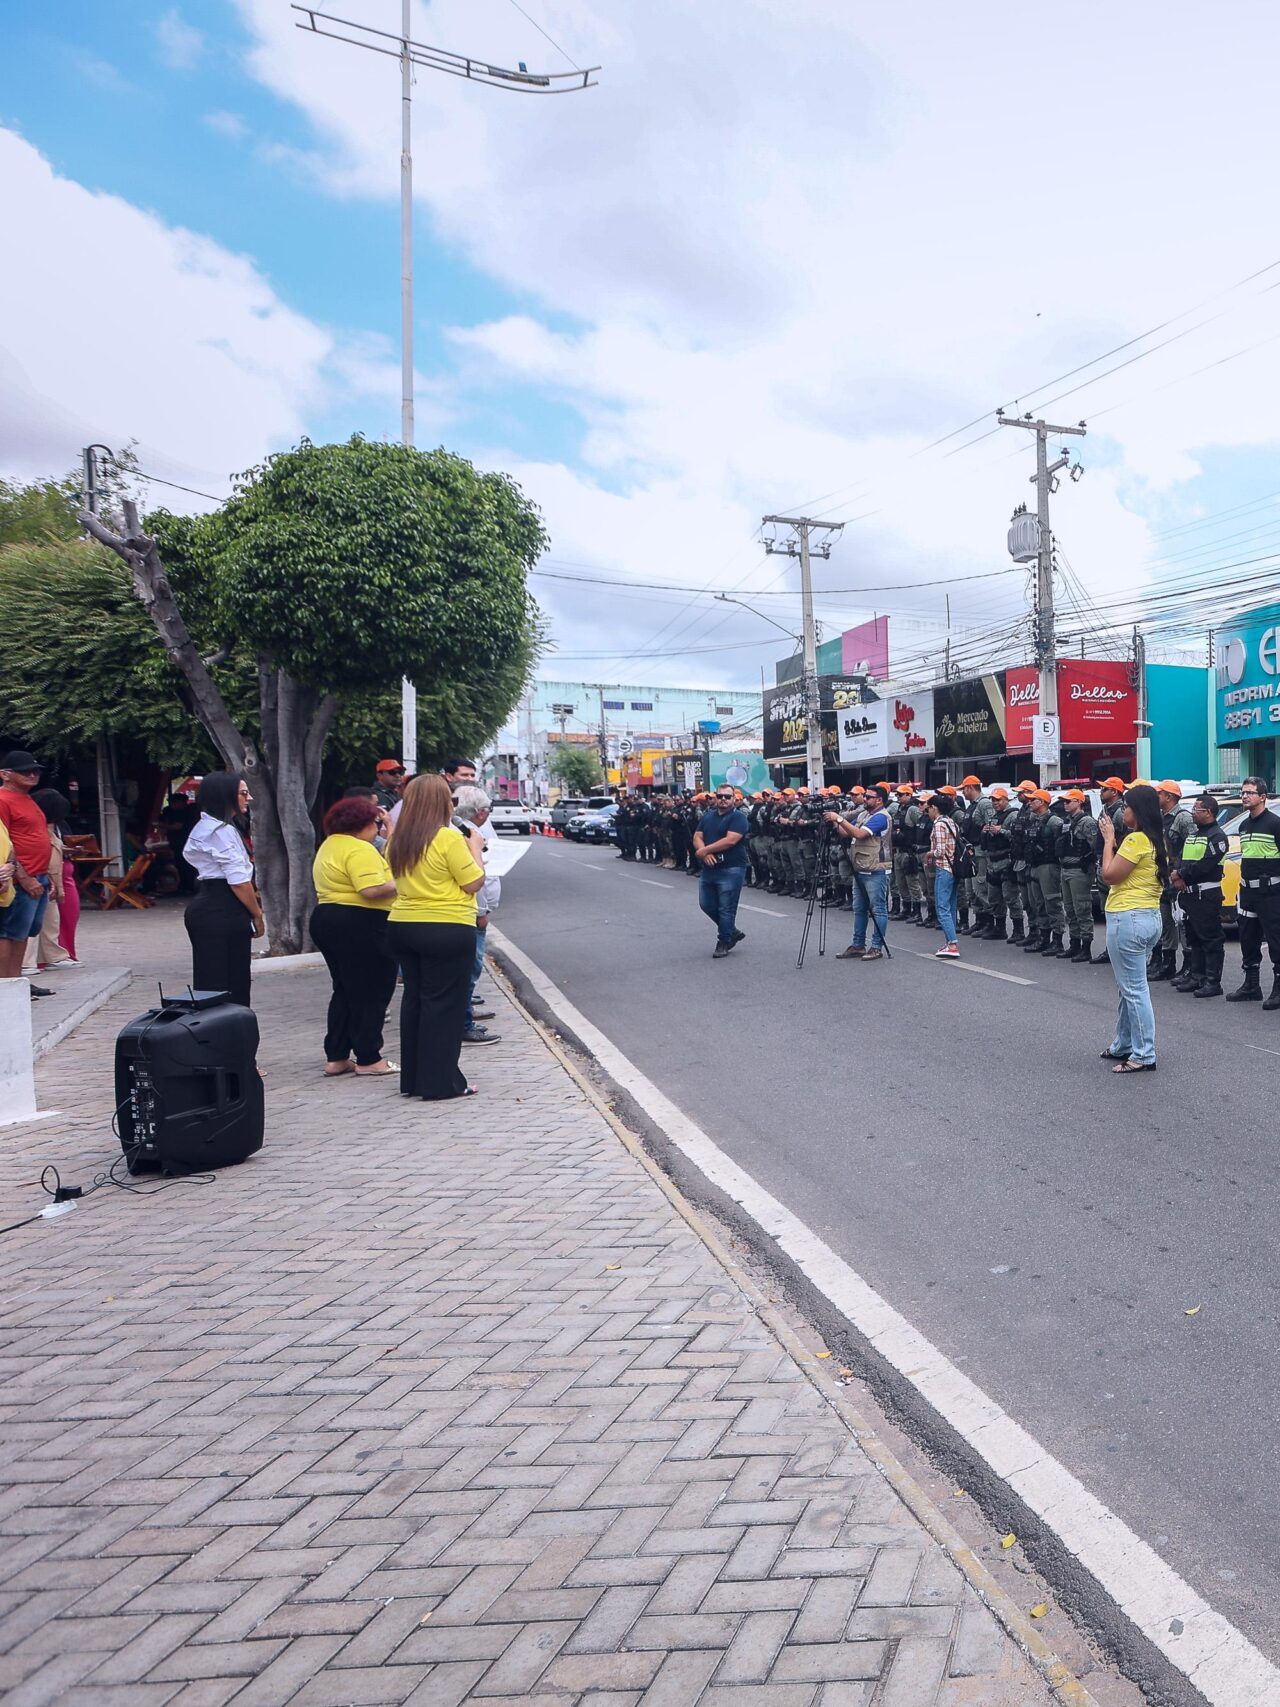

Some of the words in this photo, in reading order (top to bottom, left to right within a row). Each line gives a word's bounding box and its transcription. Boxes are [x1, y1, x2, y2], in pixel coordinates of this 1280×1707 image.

[1071, 684, 1128, 699] D'ellas
[957, 709, 989, 724] Mercado
[964, 722, 988, 734] beleza
[1043, 722, 1049, 733] E
